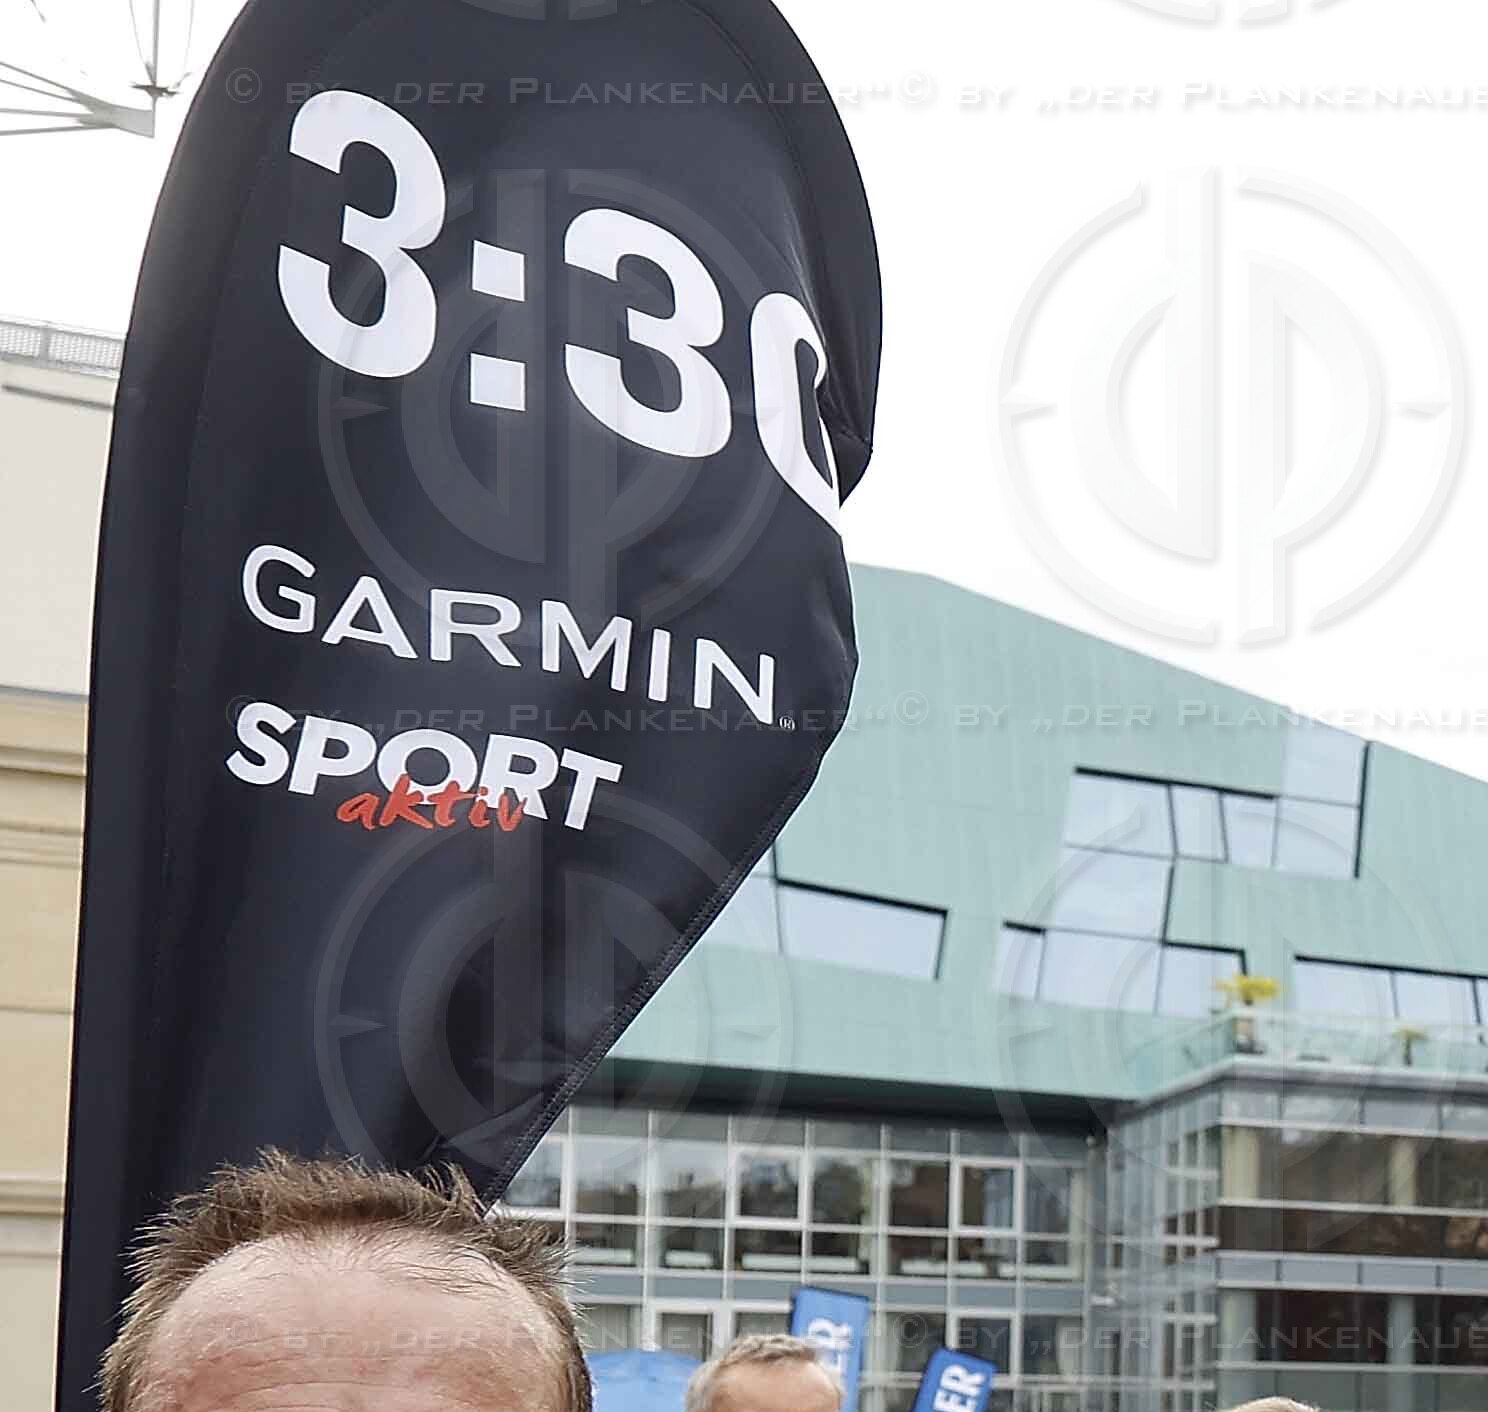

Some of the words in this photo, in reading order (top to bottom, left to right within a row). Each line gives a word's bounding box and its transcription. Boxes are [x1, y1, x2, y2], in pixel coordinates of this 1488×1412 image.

[240, 543, 777, 728] GARMIN
[226, 701, 624, 831] SPORT
[336, 773, 529, 832] aktiv
